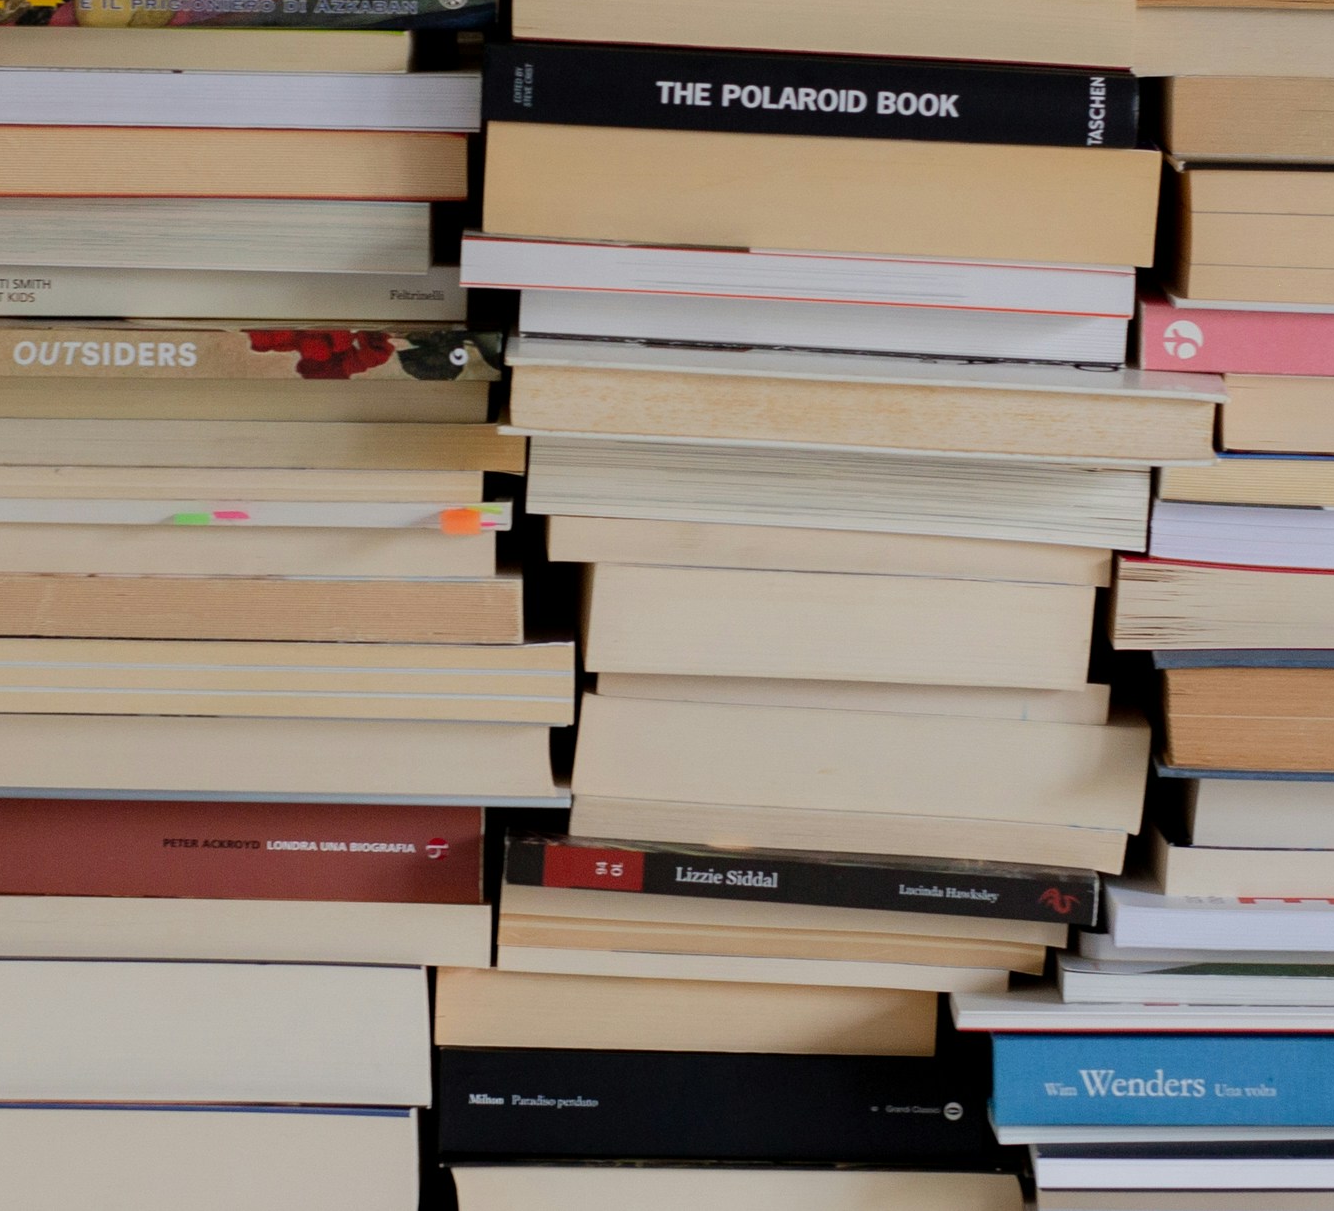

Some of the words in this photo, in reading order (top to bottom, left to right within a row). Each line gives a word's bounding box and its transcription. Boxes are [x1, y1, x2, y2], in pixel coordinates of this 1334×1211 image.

[655, 80, 713, 107] THE
[721, 83, 867, 114] POLAROID
[876, 91, 960, 118] BOOK
[1086, 76, 1107, 147] TASCHEN
[12, 278, 52, 290] SMITH
[7, 292, 36, 303] KIDS
[390, 289, 445, 301] Feltrinelli
[12, 340, 198, 368] OUTSIDERS
[163, 838, 200, 849] PETER
[202, 839, 262, 850] ACKROYD
[266, 840, 318, 852] LONDRA
[320, 841, 347, 853] UNA
[349, 842, 416, 854] BIOGRAFIA
[675, 865, 724, 885] Lizzie
[725, 869, 779, 889] Siddal
[899, 884, 944, 897] Lucinda
[945, 887, 1000, 904] Hawksley
[1043, 1082, 1078, 1097] Wim
[1078, 1068, 1207, 1098] Wenders
[1214, 1083, 1243, 1098] Una
[1244, 1083, 1278, 1098] volta
[511, 1094, 556, 1106] Paradiso
[556, 1095, 599, 1109] perduto
